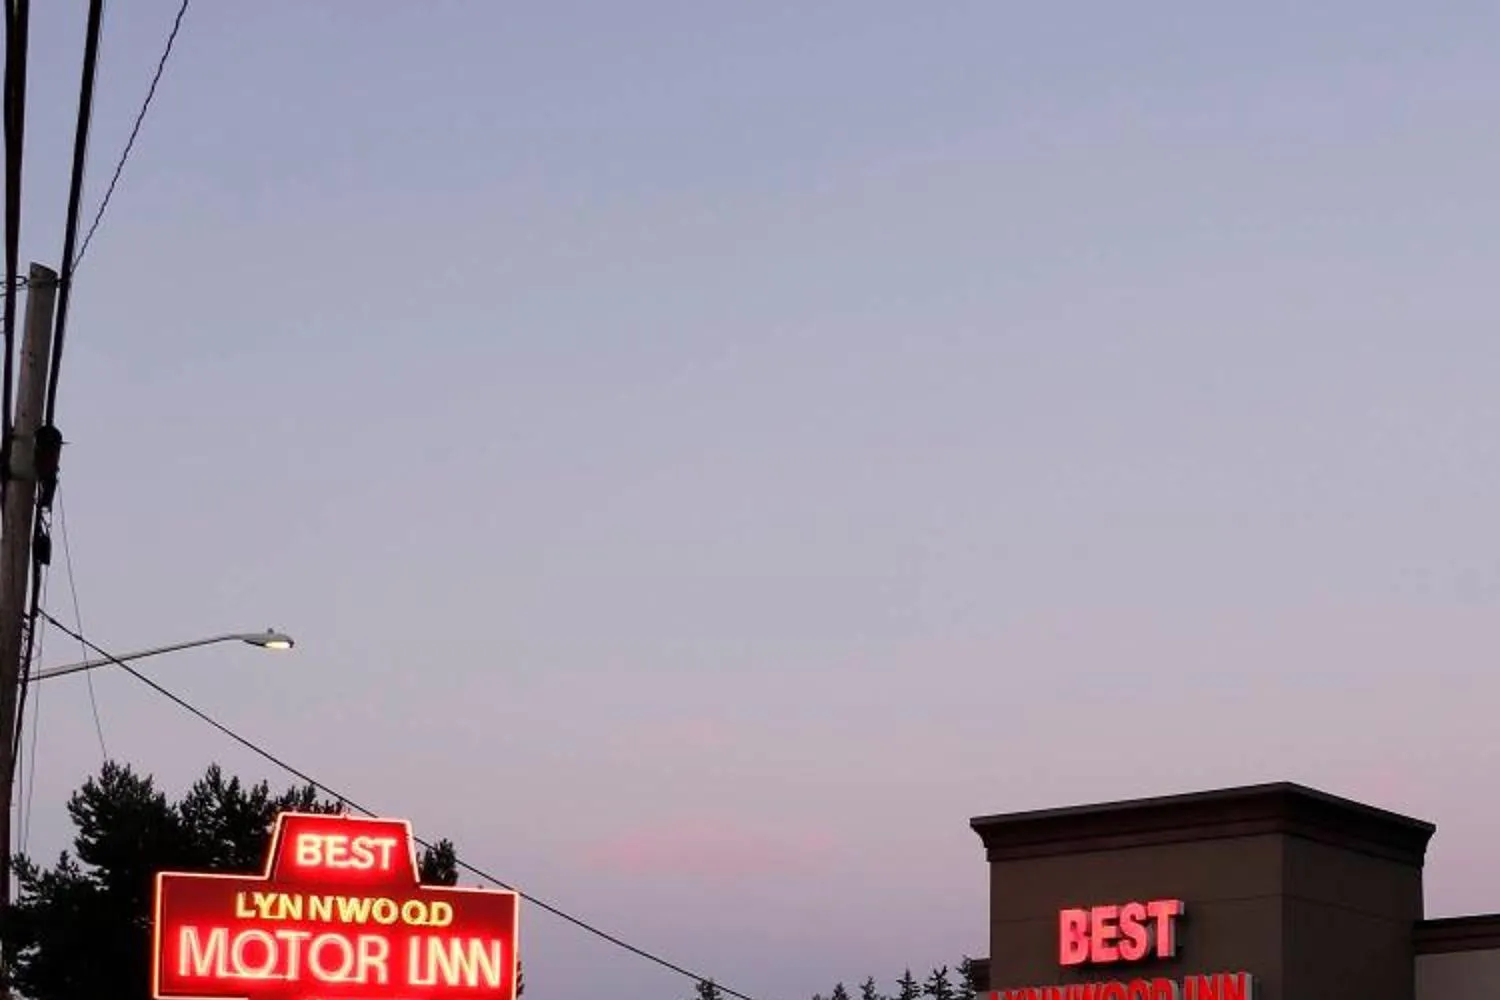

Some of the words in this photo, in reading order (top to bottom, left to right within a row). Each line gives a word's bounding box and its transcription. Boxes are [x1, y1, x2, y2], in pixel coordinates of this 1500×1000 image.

[295, 832, 398, 871] BEST
[235, 891, 454, 927] LYNNWOOD
[1059, 899, 1184, 965] BEST
[177, 925, 390, 985] MOTOR
[408, 935, 502, 988] INN
